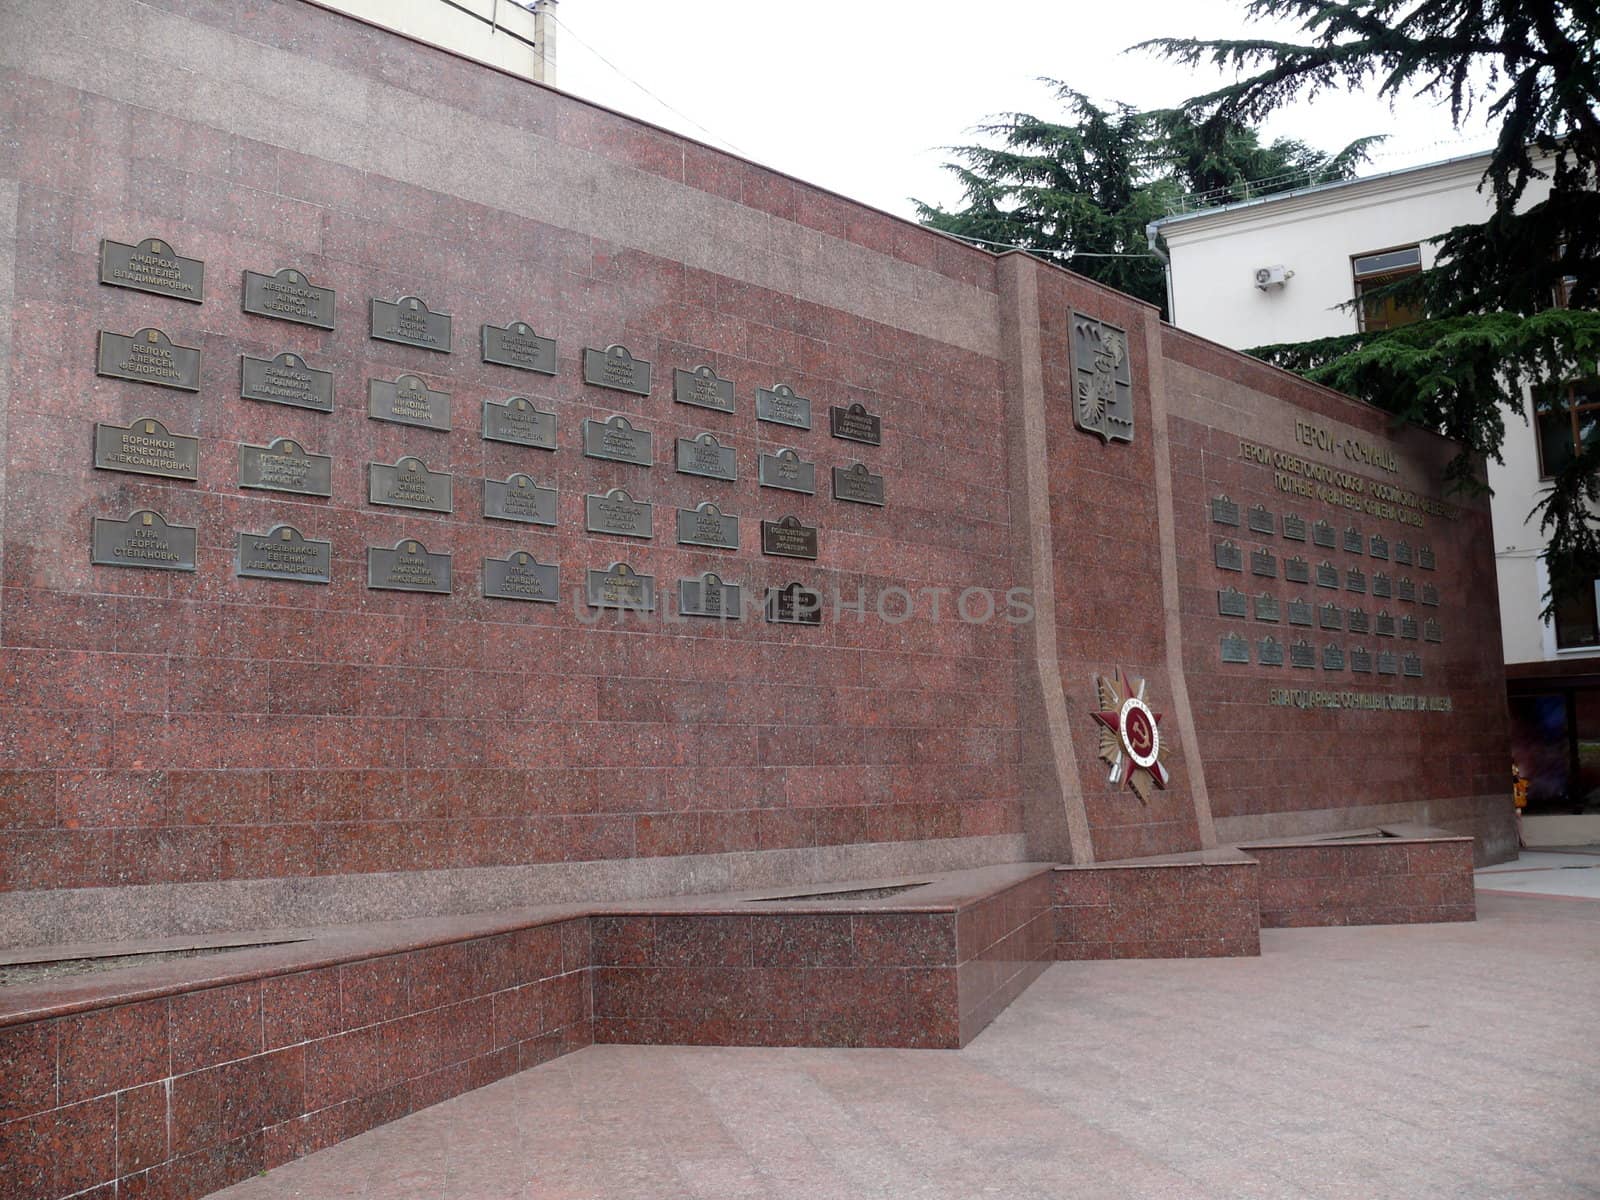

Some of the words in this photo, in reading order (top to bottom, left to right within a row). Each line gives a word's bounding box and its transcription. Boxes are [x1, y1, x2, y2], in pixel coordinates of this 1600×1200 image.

[114, 269, 194, 292] ВЛАДИМИРОВИЧ
[132, 344, 172, 358] БЕЛОУС
[120, 360, 182, 380] ФЕДОРОВИЧ
[122, 434, 176, 450] ВОРОНКОВ
[123, 444, 176, 460] ВЯЧЕСЛАВ
[105, 452, 192, 472] АЛЕКСАНДРОВИЧ
[1238, 441, 1272, 465] ГЕРОИ
[1273, 450, 1333, 483] СОВЕТСКОГО
[135, 529, 159, 540] ГУРА
[113, 547, 180, 563] СТЕПАНОВИЧ
[247, 560, 325, 577] АЛЕКСАНДРОВИЧ
